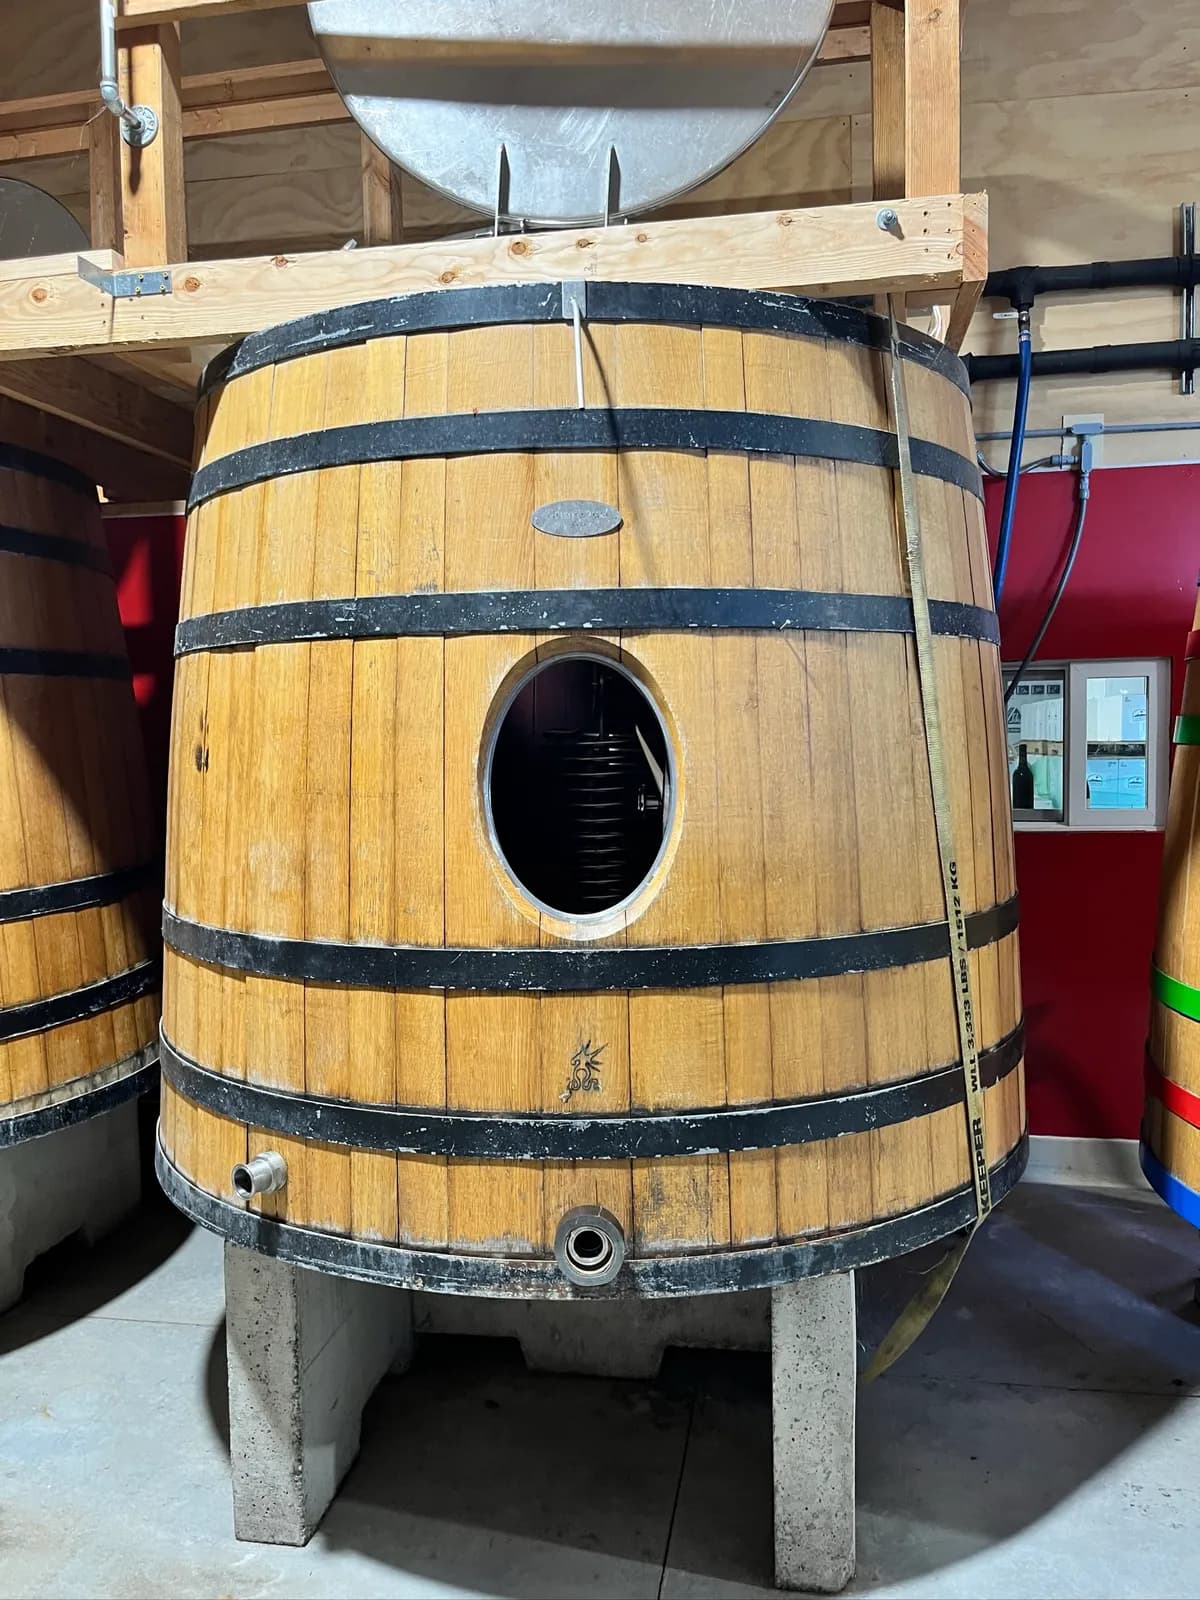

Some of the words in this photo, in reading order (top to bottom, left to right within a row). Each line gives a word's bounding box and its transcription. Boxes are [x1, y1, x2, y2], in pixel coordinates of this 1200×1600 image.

[949, 861, 958, 890] KG
[953, 896, 963, 940] 1512
[960, 958, 968, 993] LBS
[969, 1054, 978, 1093] WLL
[972, 1117, 990, 1214] KEEPER
